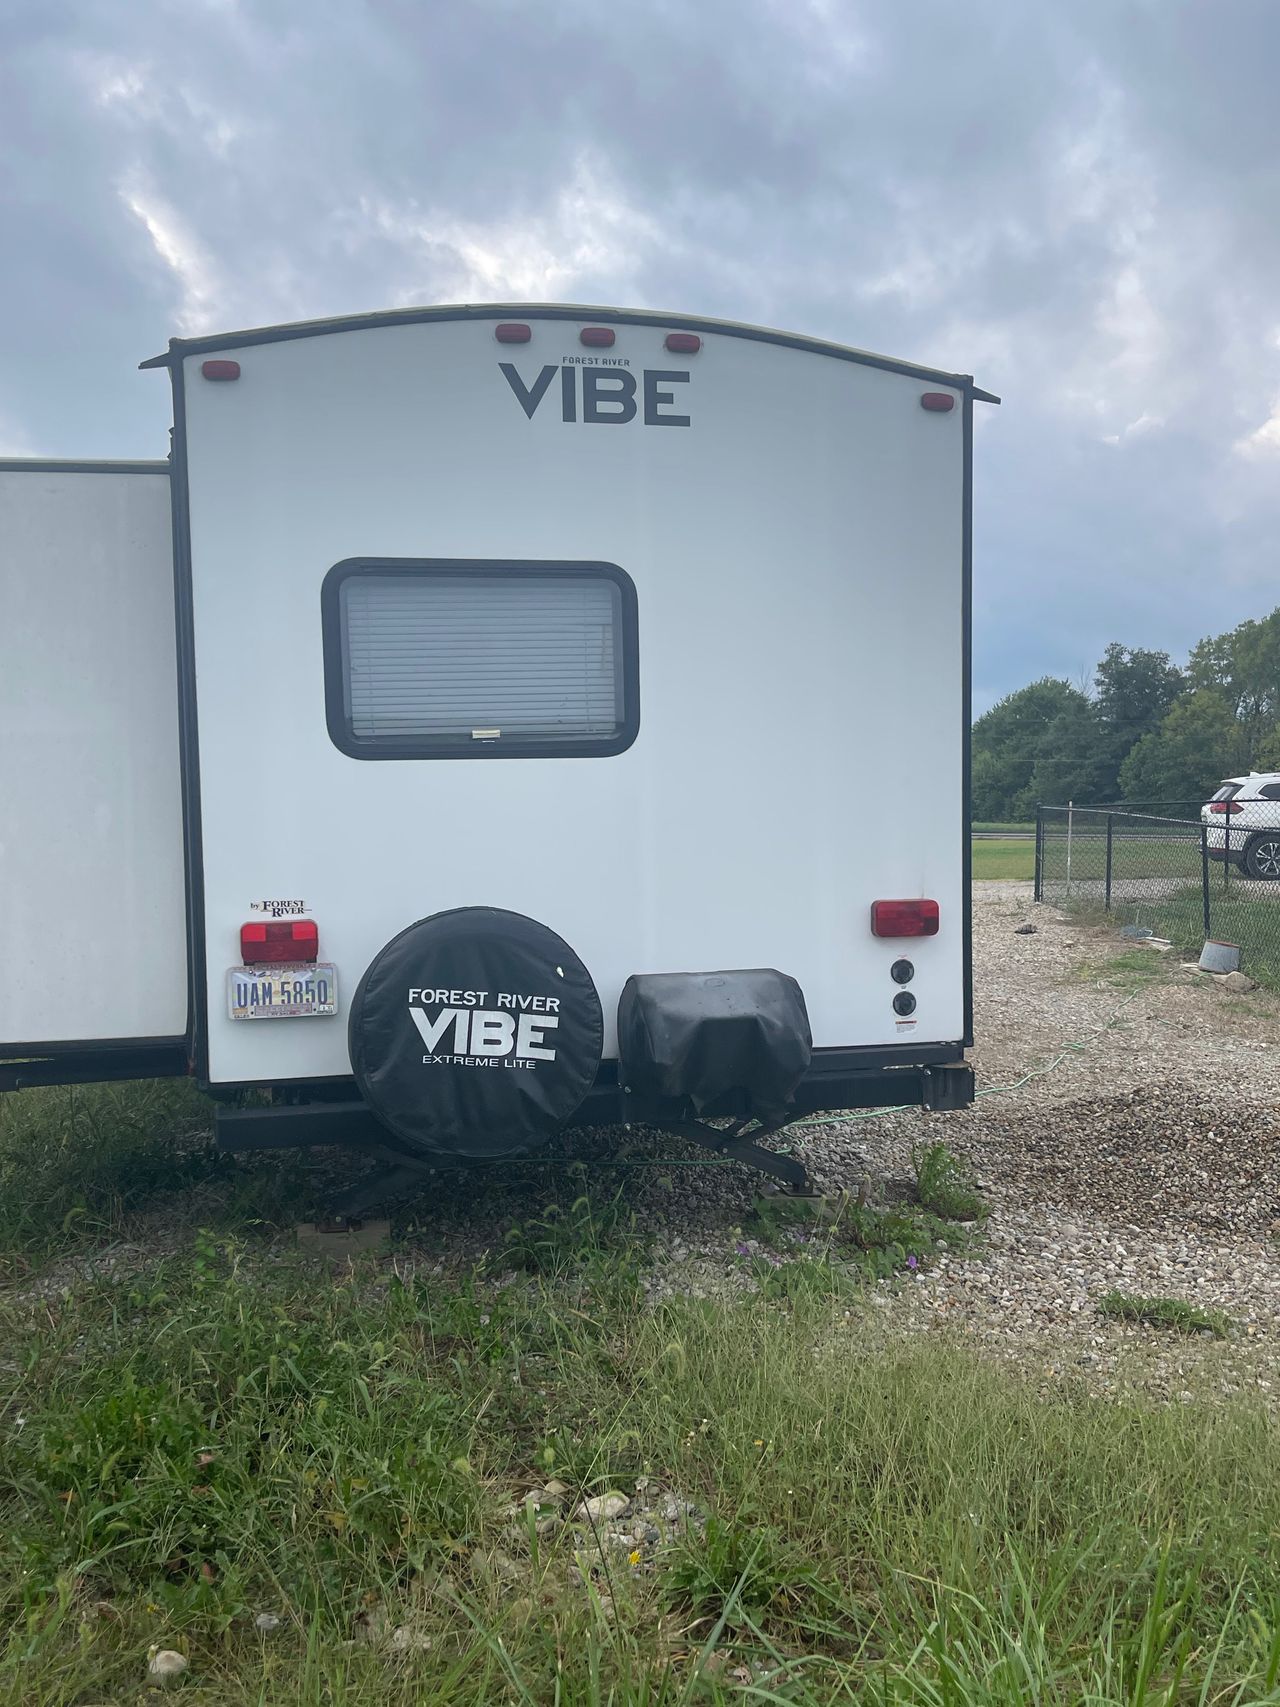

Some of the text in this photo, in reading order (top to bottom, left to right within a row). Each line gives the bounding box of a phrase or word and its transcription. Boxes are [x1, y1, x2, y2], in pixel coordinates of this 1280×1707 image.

[562, 356, 630, 367] FOREST RIVER
[498, 363, 691, 427] VIBE
[262, 900, 305, 911] FOREST
[272, 907, 305, 917] RIVER
[237, 979, 328, 1008] UAM 5850
[408, 988, 561, 1012] FOREST RIVER
[408, 1007, 559, 1061] VIBE
[422, 1055, 536, 1069] EXTREME LITE
